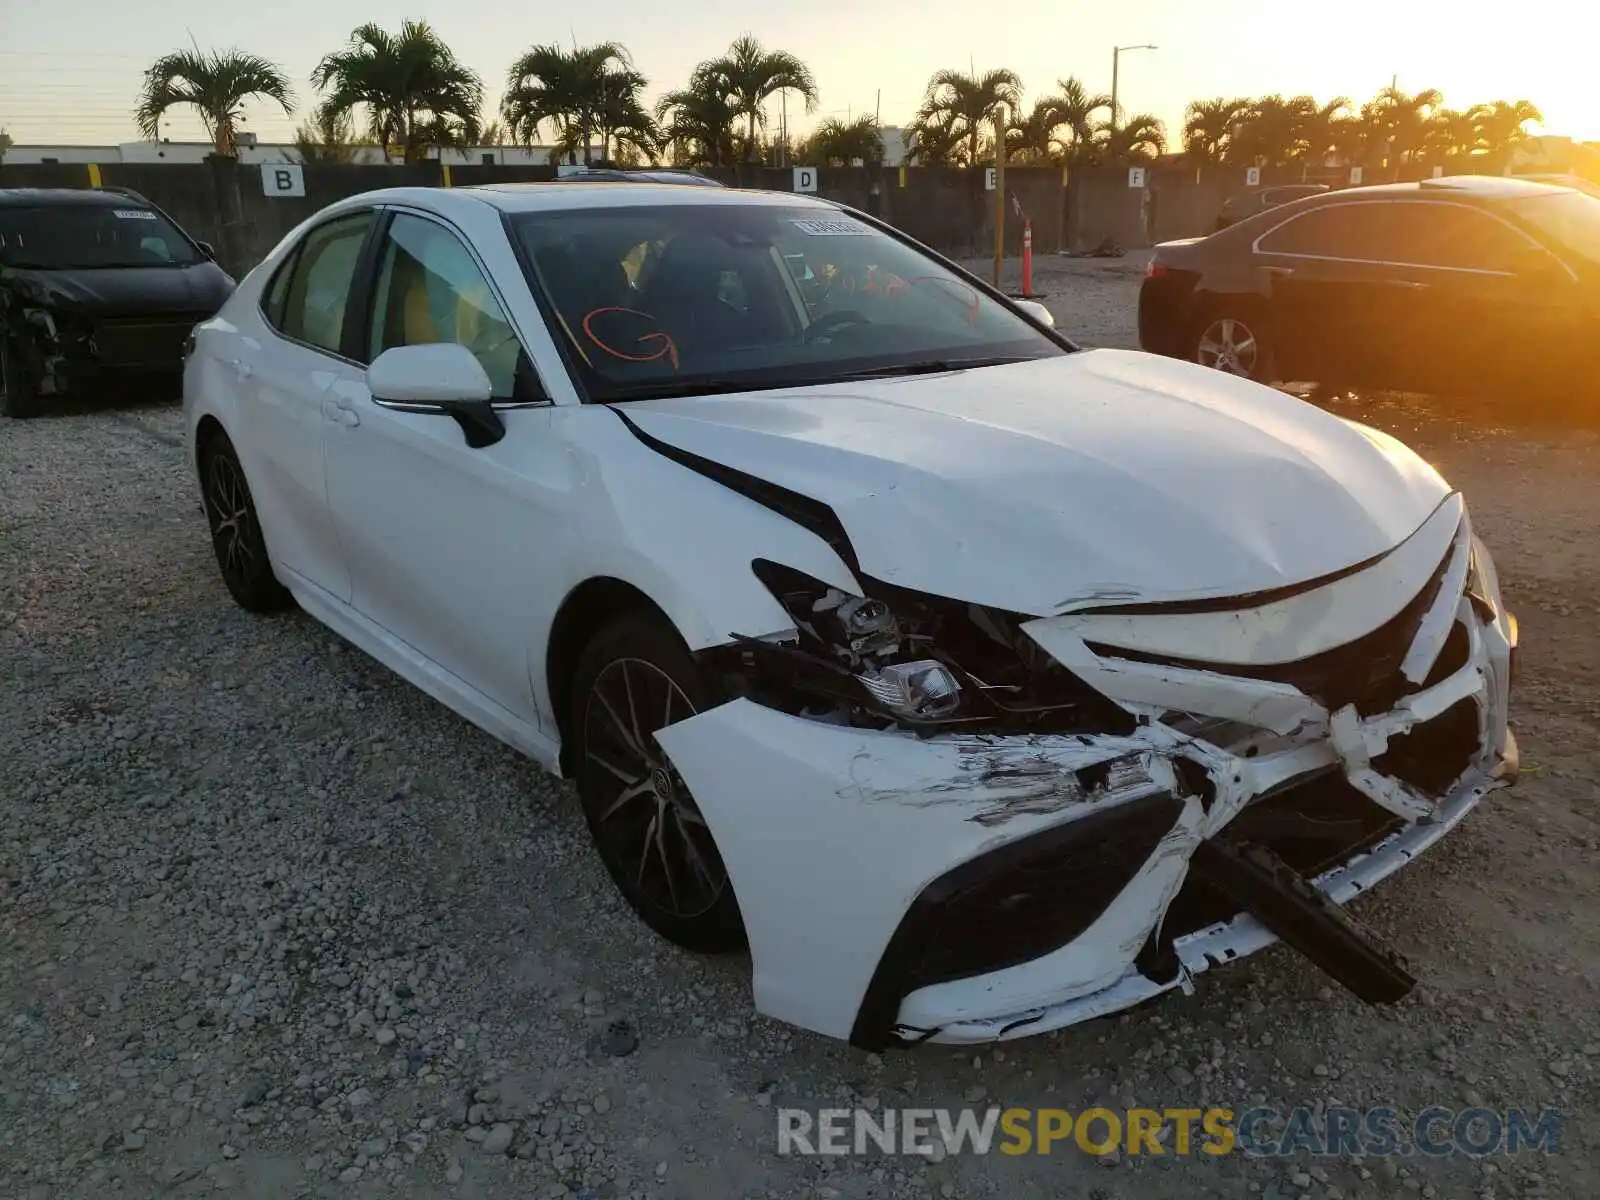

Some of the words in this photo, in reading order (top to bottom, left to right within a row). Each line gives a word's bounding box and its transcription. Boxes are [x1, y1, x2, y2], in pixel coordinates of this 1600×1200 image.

[275, 170, 293, 190] B
[801, 172, 811, 187] D
[1133, 171, 1141, 185] F
